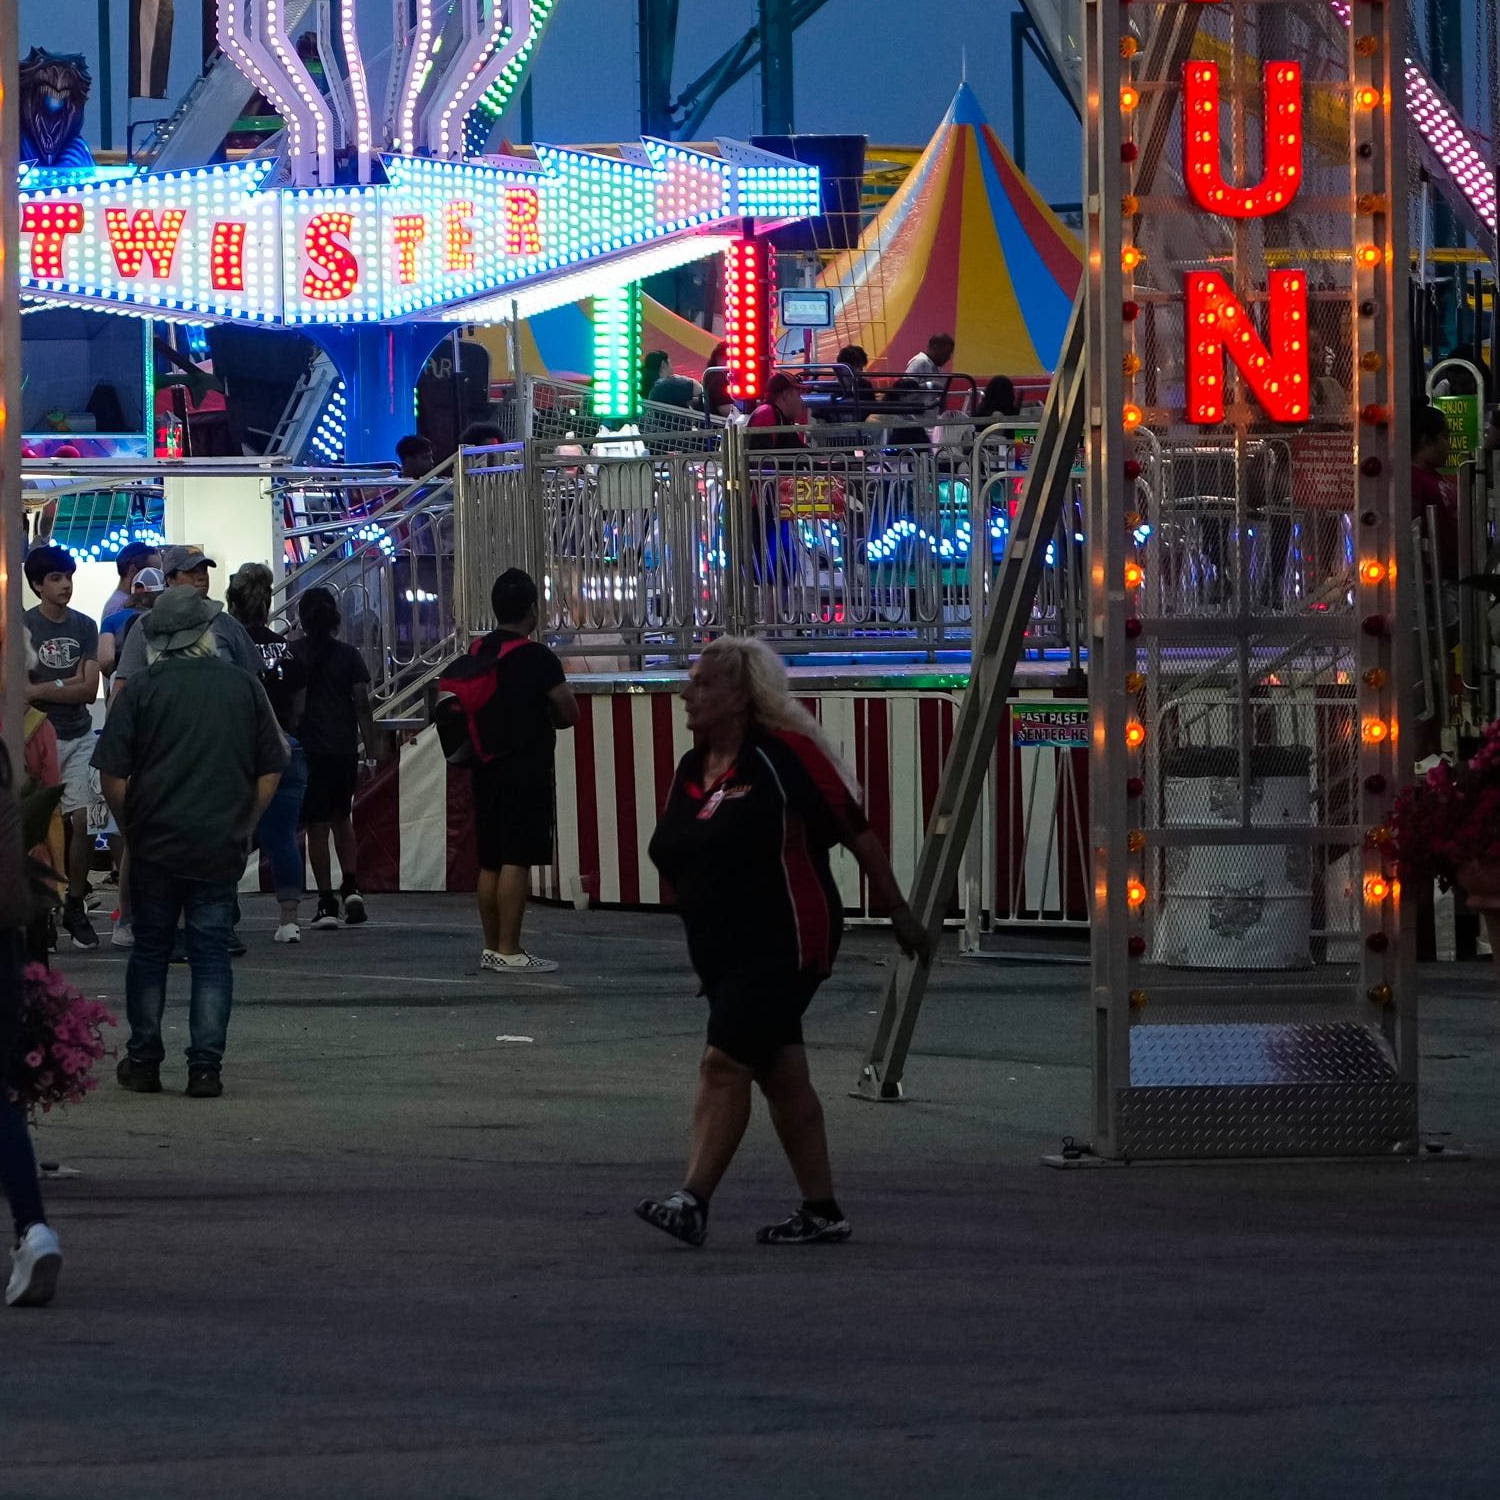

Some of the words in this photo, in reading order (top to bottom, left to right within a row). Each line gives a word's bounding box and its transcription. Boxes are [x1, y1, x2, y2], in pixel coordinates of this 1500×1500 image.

[20, 186, 542, 300] TWISTER
[1441, 401, 1468, 414] ENJOY
[1448, 418, 1464, 431] THE
[1450, 436, 1468, 449] AVE
[1020, 712, 1046, 723] FAST
[1049, 712, 1077, 725] PASS
[1027, 728, 1065, 741] ENTER
[1071, 728, 1087, 741] HE
